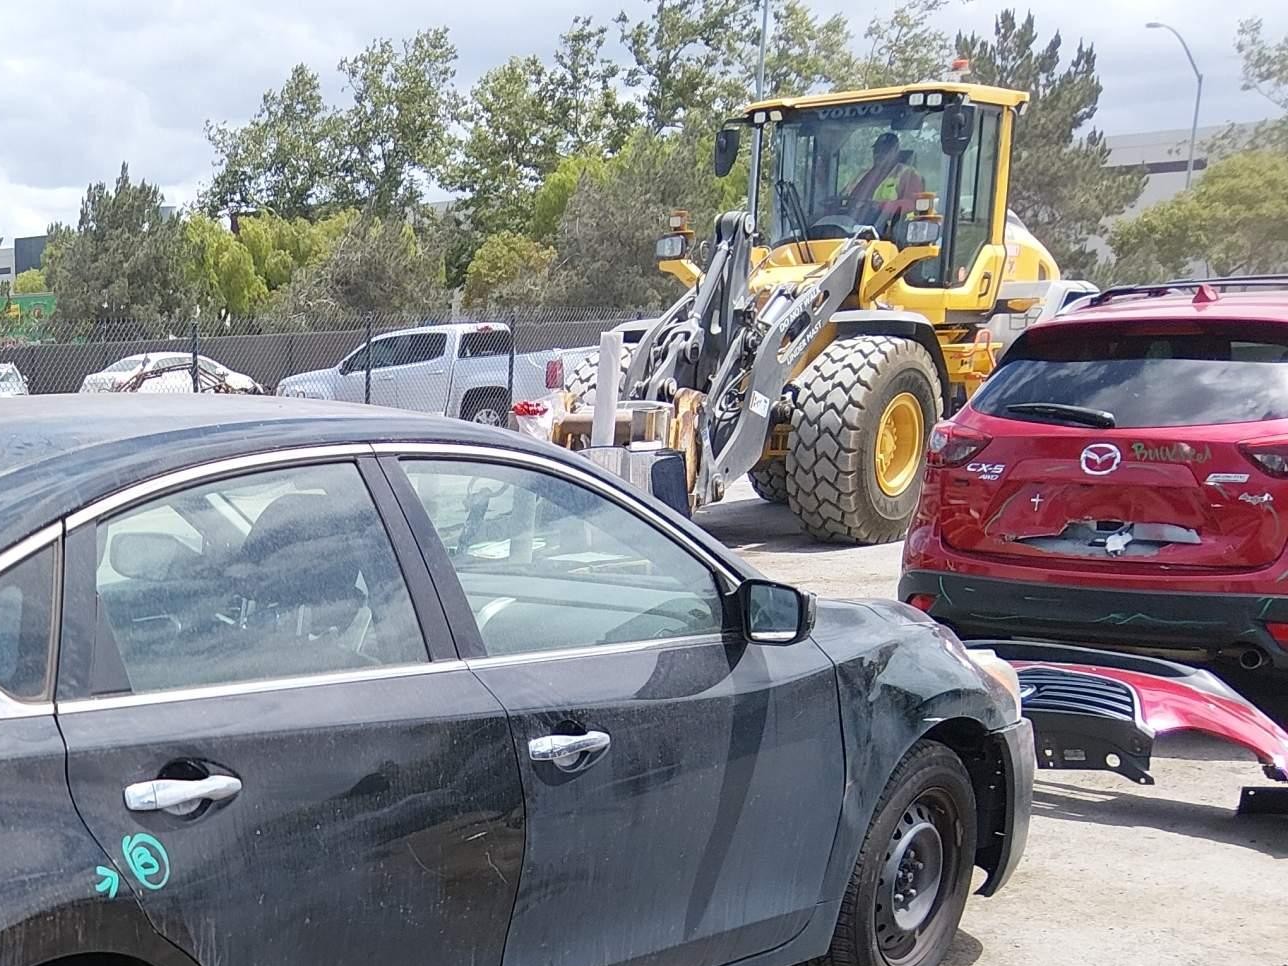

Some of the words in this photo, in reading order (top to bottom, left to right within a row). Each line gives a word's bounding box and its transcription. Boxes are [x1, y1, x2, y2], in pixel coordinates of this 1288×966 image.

[815, 103, 884, 121] VOLVO
[778, 319, 791, 333] DO
[789, 302, 804, 322] NOT
[786, 339, 808, 366] UNDER
[805, 319, 823, 342] MAST
[966, 462, 1006, 474] CX-5
